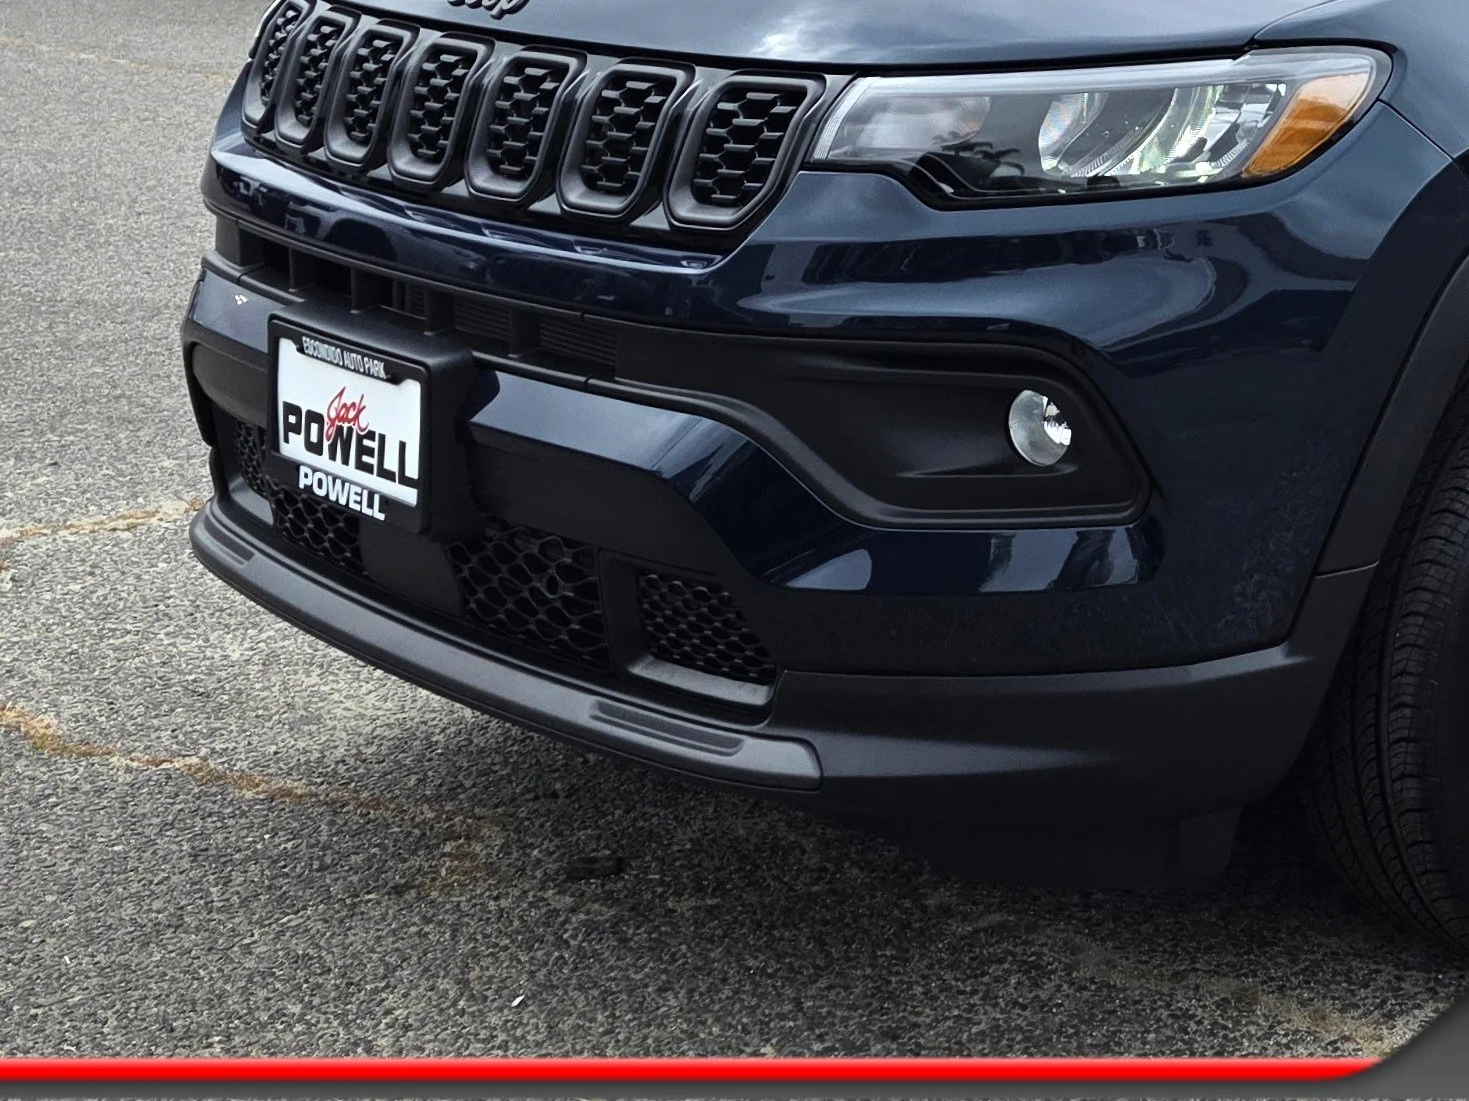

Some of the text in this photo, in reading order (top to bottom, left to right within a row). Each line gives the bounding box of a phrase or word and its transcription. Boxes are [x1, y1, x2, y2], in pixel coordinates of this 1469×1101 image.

[302, 335, 387, 380] ESCONDIDO AUTO PARK
[325, 386, 370, 442] Jack
[282, 400, 418, 491] POWELL
[299, 464, 386, 521] POWELL
